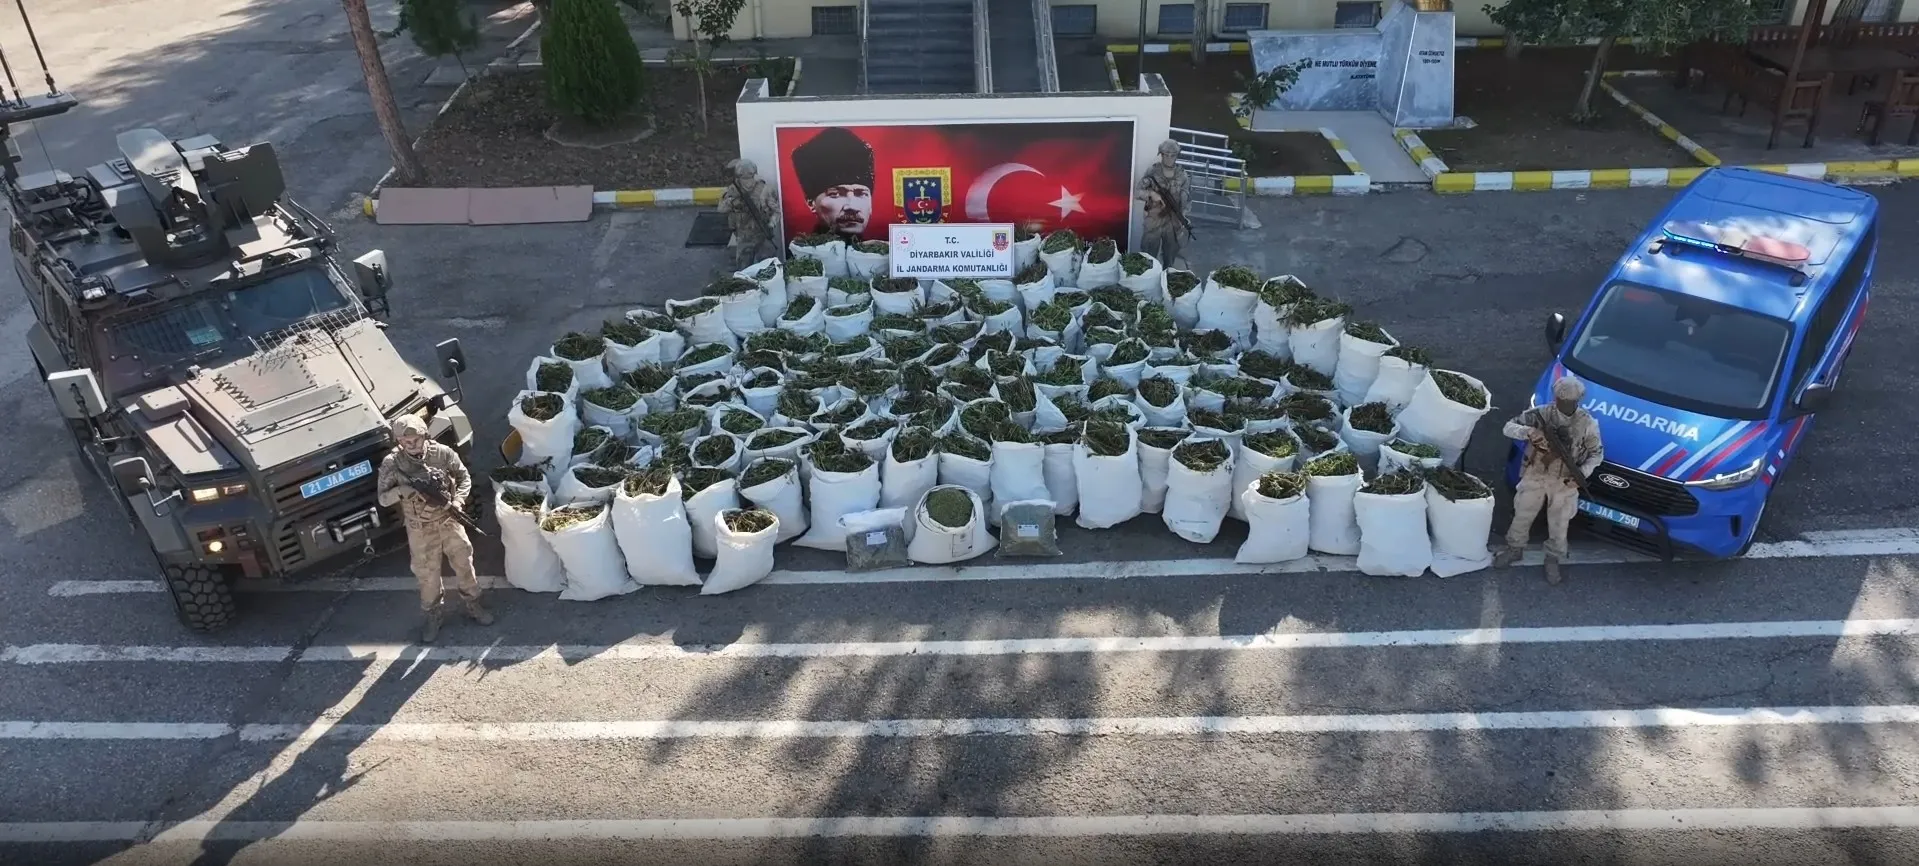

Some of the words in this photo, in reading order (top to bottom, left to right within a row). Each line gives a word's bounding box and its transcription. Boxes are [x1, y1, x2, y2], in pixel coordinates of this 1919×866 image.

[1322, 60, 1339, 68] MUTLU
[945, 236, 960, 244] T.C.
[909, 250, 959, 258] DİYARBAKIR
[961, 250, 994, 258] VALİLİĞİ
[896, 264, 904, 273] İL
[906, 265, 950, 273] JANDARMA
[952, 264, 1008, 273] KOMUTANLIĞI
[1582, 398, 1699, 442] JANDARMA
[308, 482, 322, 494] 21
[326, 473, 345, 487] JAA
[348, 463, 368, 477] 466
[1603, 474, 1625, 488] Ford
[1578, 499, 1591, 511] 21
[1595, 505, 1613, 519] JAA
[1619, 512, 1637, 526] 750
